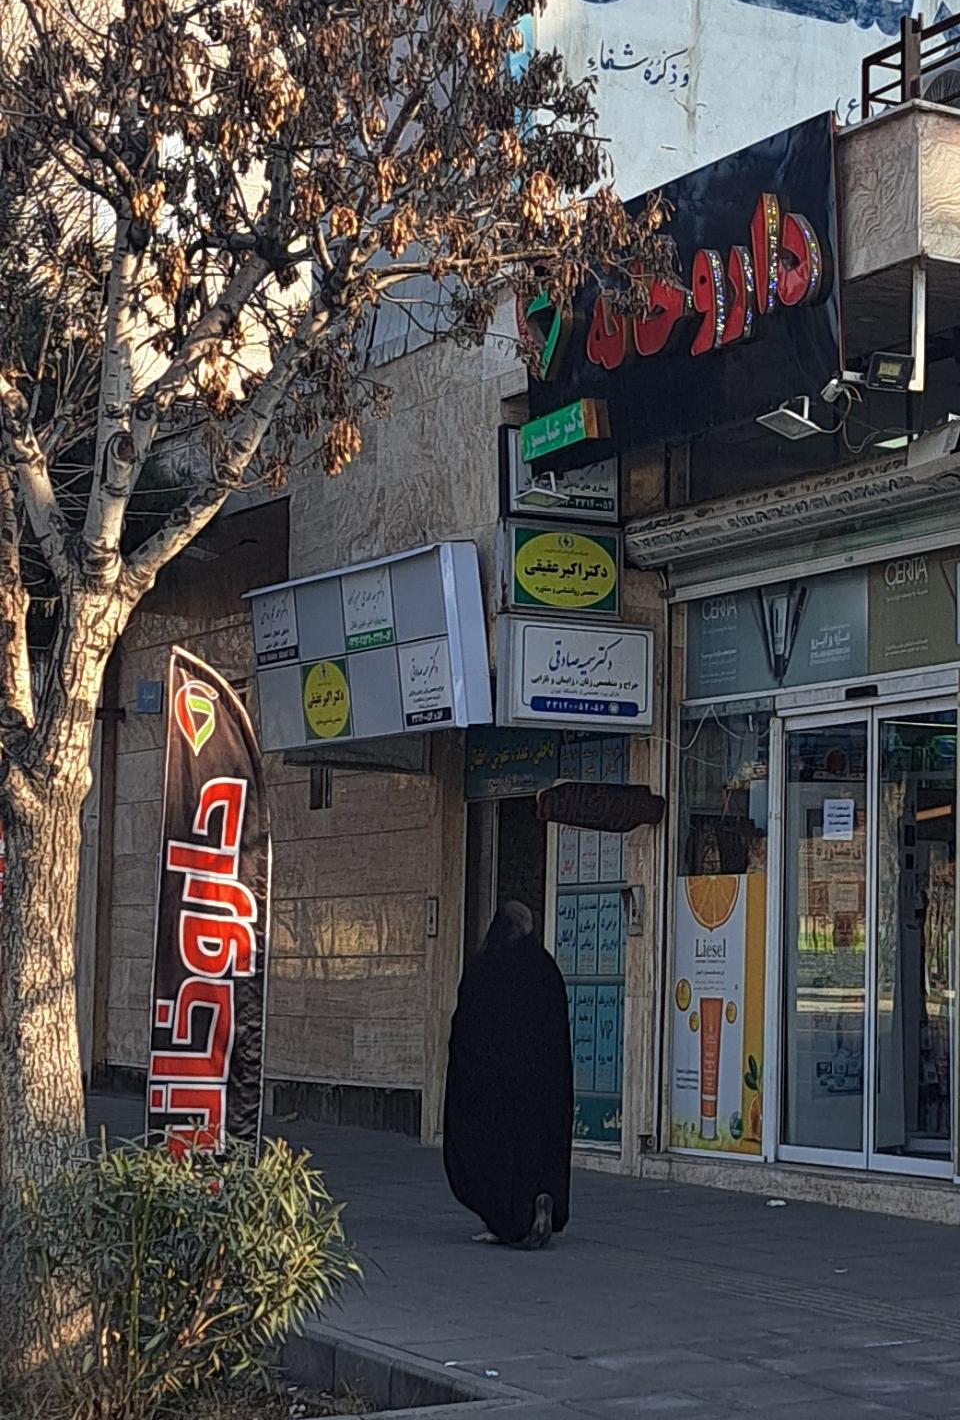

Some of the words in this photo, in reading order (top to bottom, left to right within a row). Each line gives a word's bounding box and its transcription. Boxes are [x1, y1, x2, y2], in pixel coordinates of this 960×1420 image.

[586, 192, 822, 370] داروخانه
[558, 562, 582, 579] اکبر
[582, 563, 608, 580] دکتر
[549, 640, 578, 671] صادقی
[577, 656, 596, 675] سمیه
[590, 637, 623, 672] دکتر
[694, 938, 727, 959] Liesel
[148, 777, 258, 1157] داروخانه
